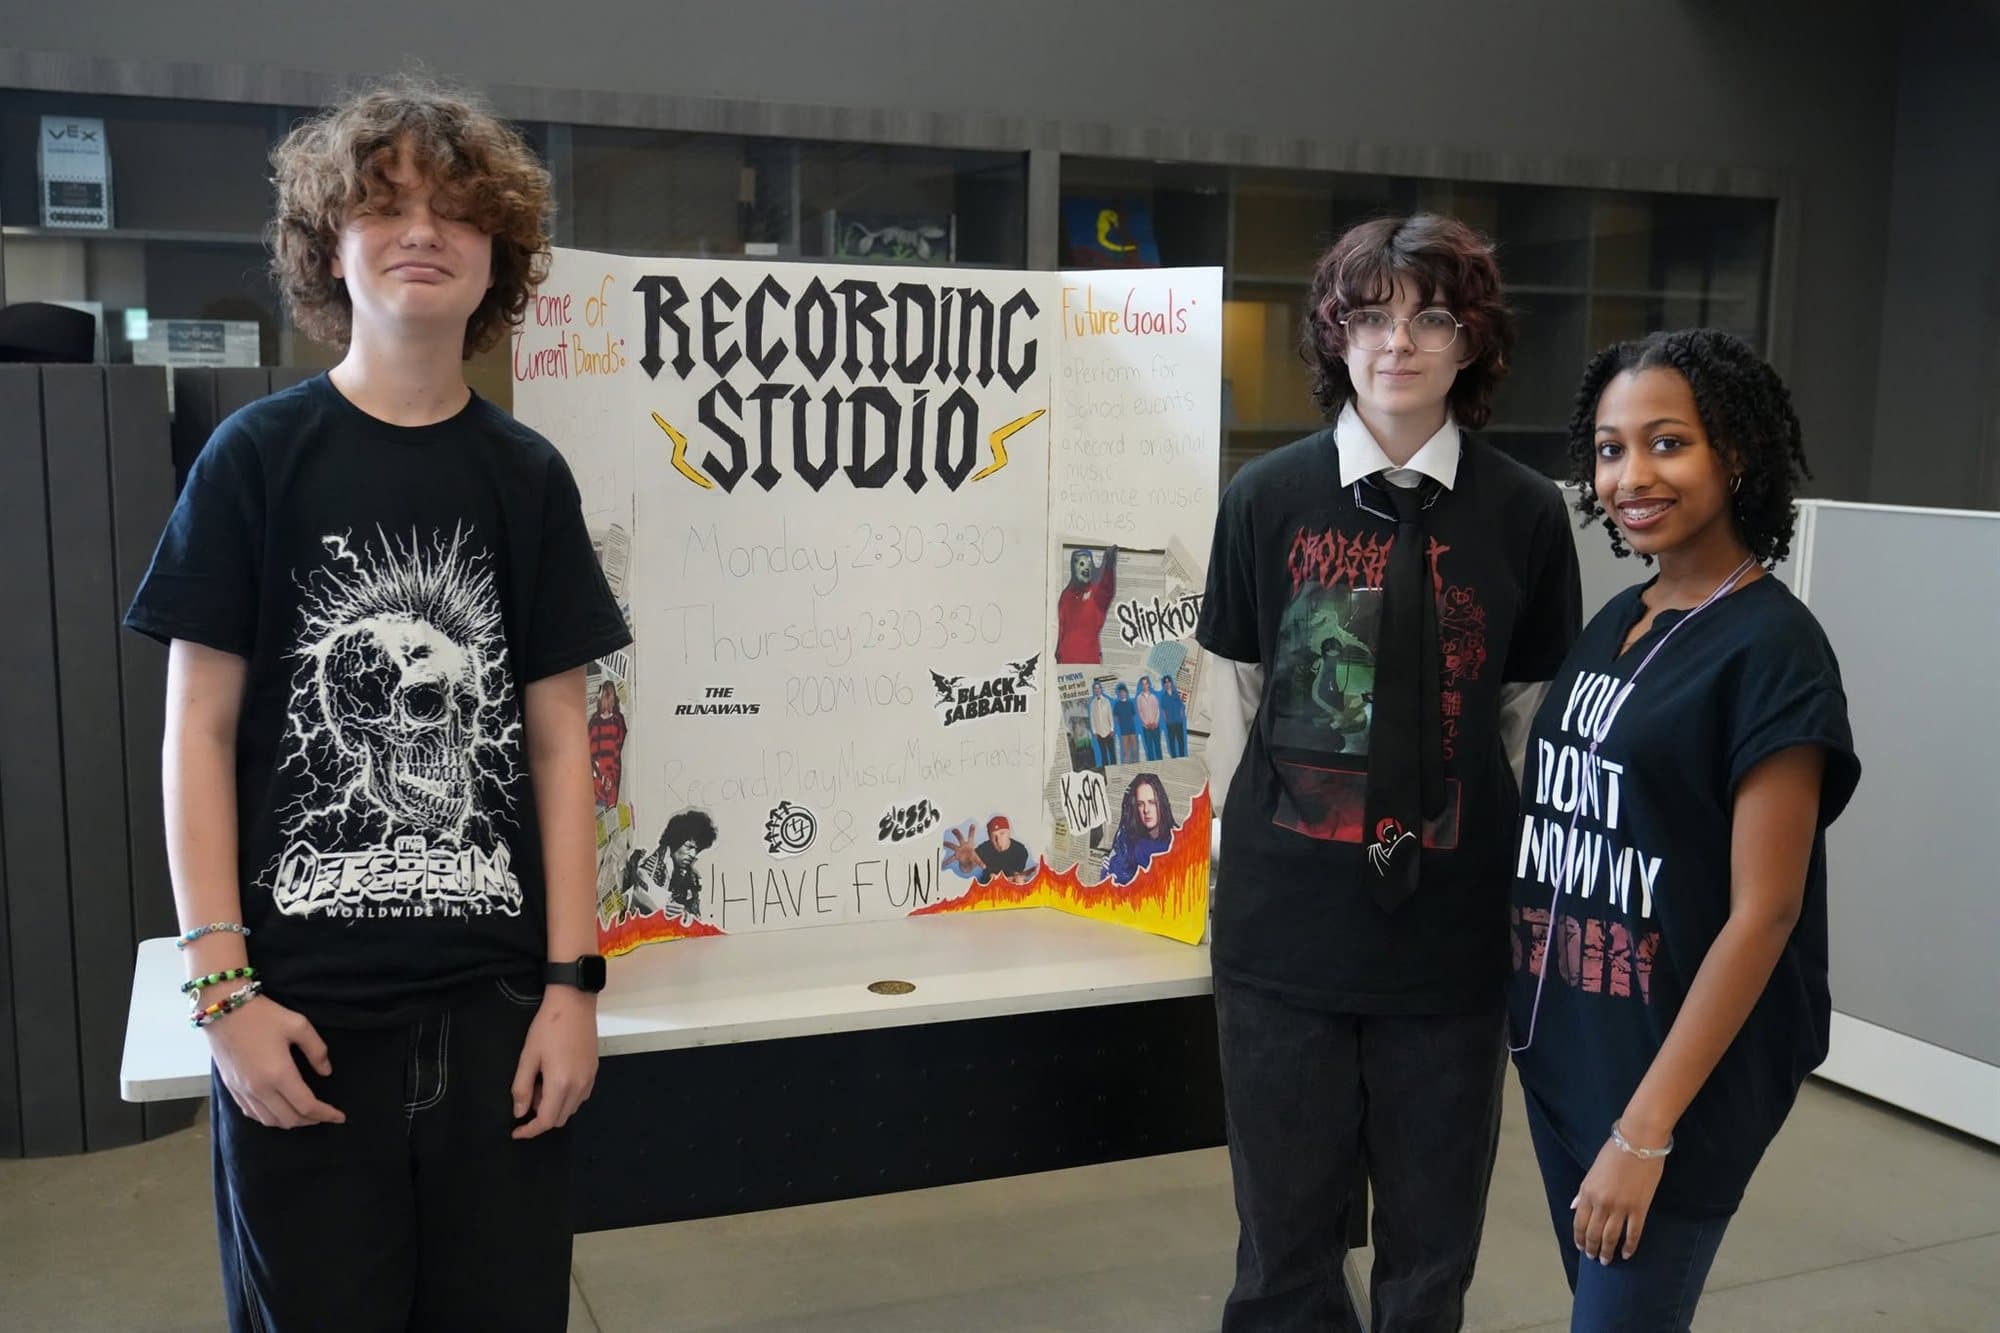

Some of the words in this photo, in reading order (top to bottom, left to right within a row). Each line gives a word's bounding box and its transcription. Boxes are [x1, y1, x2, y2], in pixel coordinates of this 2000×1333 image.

[48, 124, 97, 142] VEX
[585, 273, 616, 329] of
[1062, 283, 1120, 343] Future
[663, 592, 855, 668] Thursday
[674, 703, 761, 716] RUNAWAYS
[705, 687, 734, 699] THE
[785, 675, 857, 718] ROOM
[865, 673, 914, 706] 106
[943, 694, 1027, 727] SABBATH
[957, 677, 1015, 705] BLACK
[1560, 671, 1635, 744] YOU
[829, 809, 857, 854] &
[851, 848, 941, 916] FUN!
[1606, 839, 1664, 920] MY
[325, 904, 435, 918] WORLDWIDE
[443, 902, 461, 918] IN
